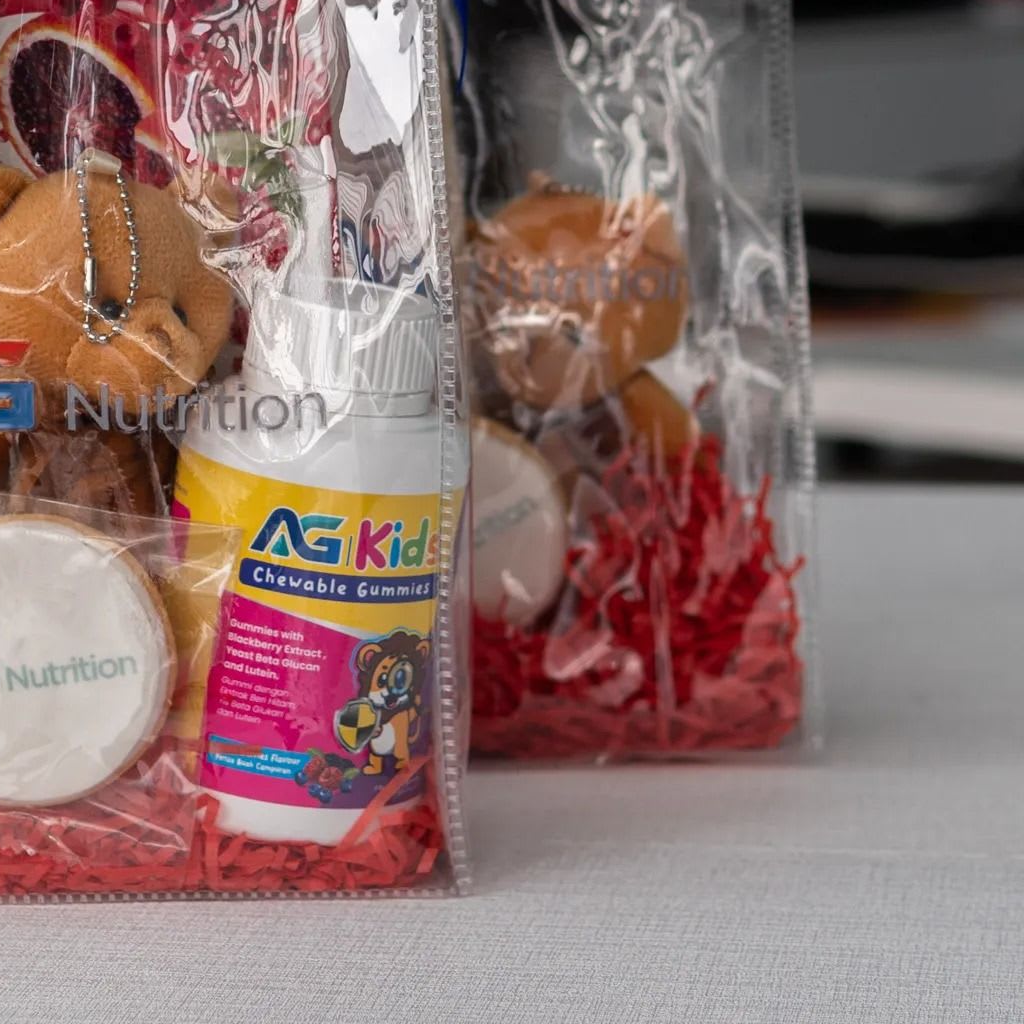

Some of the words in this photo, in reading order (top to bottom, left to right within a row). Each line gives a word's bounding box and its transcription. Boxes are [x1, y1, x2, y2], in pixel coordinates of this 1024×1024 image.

[66, 382, 329, 433] Nutrition
[253, 566, 347, 596] Chewable
[356, 580, 432, 599] Gummies
[227, 631, 283, 655] Blackberry
[230, 618, 279, 638] Gummies
[280, 630, 305, 643] with
[4, 653, 138, 692] Nutrition
[223, 660, 244, 673] and
[225, 645, 255, 661] Yeast
[255, 652, 280, 666] Beta
[281, 658, 321, 673] Glucan
